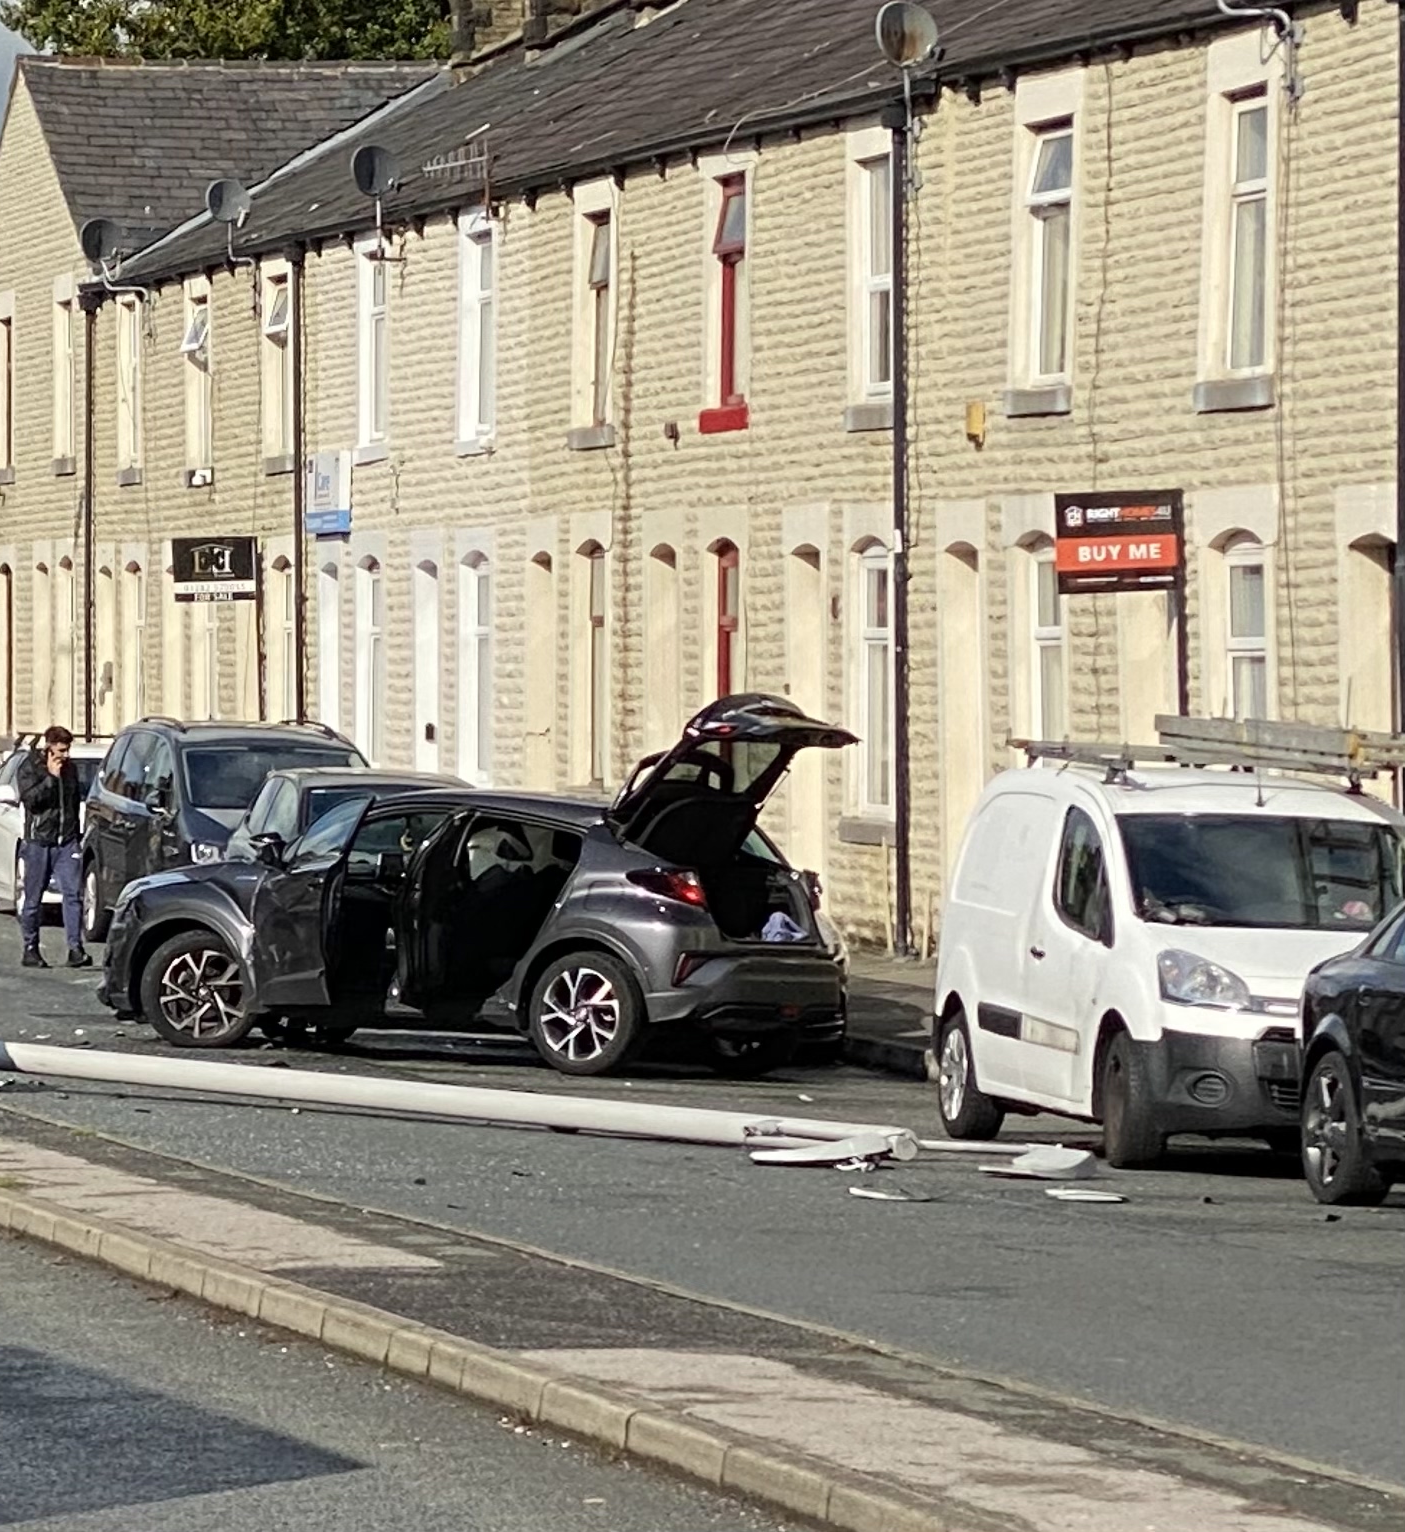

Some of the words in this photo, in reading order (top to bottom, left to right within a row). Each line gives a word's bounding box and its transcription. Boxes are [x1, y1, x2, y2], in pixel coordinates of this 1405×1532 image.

[1078, 545, 1121, 562] BUY
[1129, 543, 1161, 560] ME
[195, 593, 212, 601] FOR
[215, 592, 233, 601] SALE
